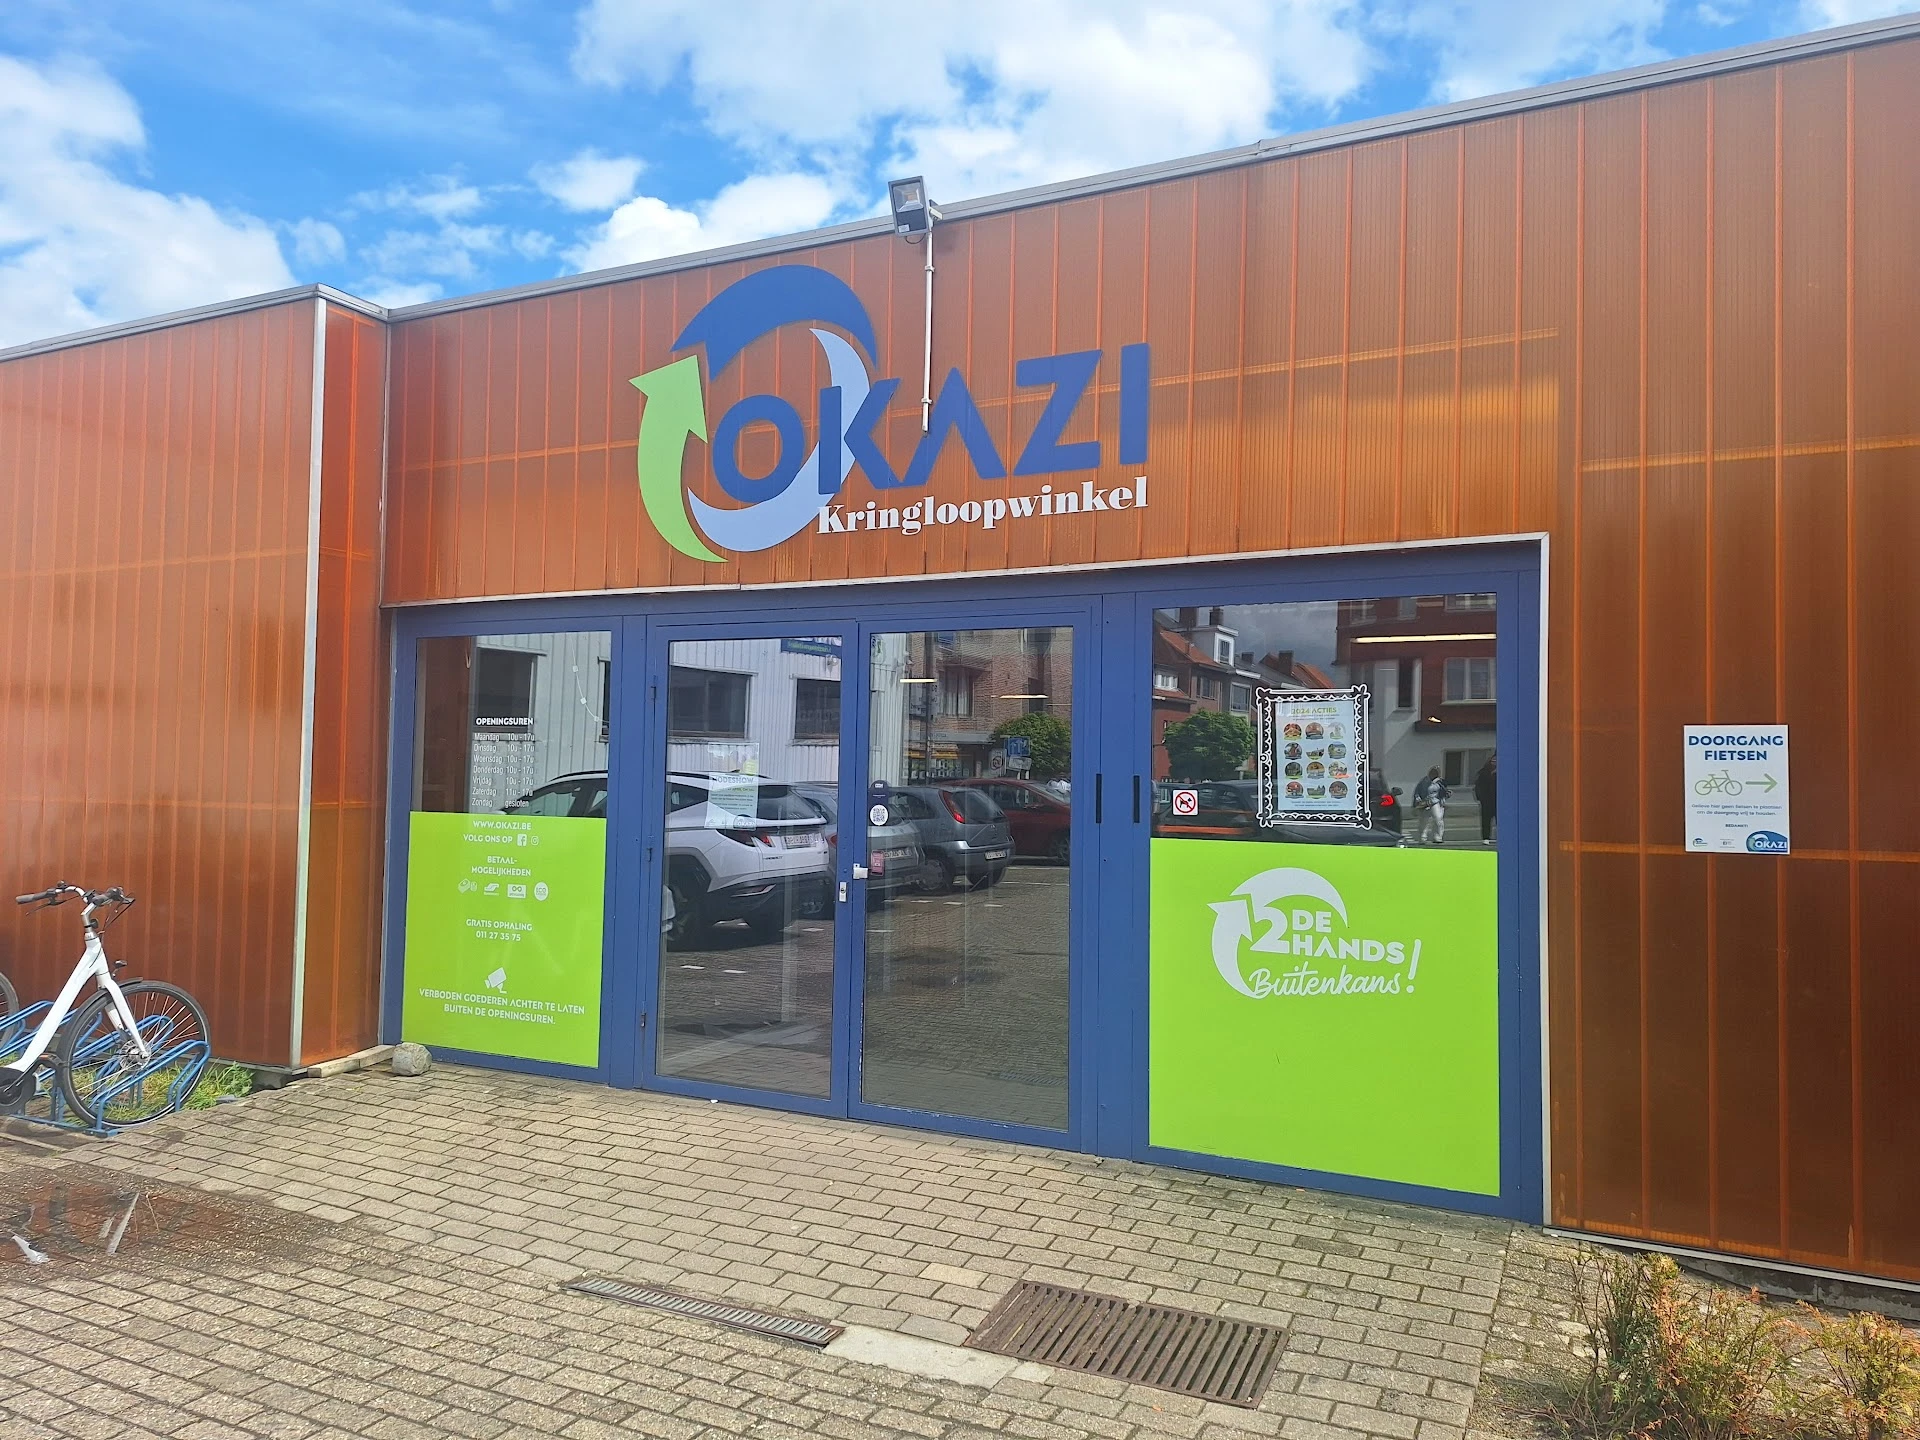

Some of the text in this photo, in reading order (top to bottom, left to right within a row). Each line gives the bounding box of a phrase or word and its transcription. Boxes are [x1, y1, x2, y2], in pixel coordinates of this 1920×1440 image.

[711, 342, 1150, 504] OKAZI
[816, 476, 1149, 536] Kringloopwinkel
[476, 717, 534, 726] OPENINGSUREN
[474, 733, 500, 742] Maandag
[508, 733, 518, 741] 10u
[524, 733, 535, 741] 17u
[1688, 735, 1784, 746] DOORGANG
[473, 744, 497, 753] Dinsdag
[507, 744, 517, 752] 10u
[524, 744, 535, 752] 17u
[473, 755, 503, 764] Woensdag
[507, 755, 517, 763] 10u
[523, 755, 534, 763] 17u
[1704, 750, 1768, 761] FIETSEN
[473, 766, 504, 775] Donderdag
[506, 766, 517, 774] 10u
[523, 766, 534, 774] 17u
[472, 777, 492, 786] Vrijdag
[506, 777, 517, 785] 10u
[523, 777, 534, 785] 17u
[472, 787, 497, 796] Zaterdag
[506, 788, 516, 796] 11u
[522, 788, 533, 796] 17u
[471, 798, 530, 808] Zondag gesloten
[473, 820, 532, 830] WWW.OKAZI.BE
[463, 833, 513, 844] VOLG ONS OP
[1755, 840, 1787, 849] OKAZI
[487, 855, 518, 865] BETAAL-
[471, 865, 531, 877] MOGELIJKHEDEN
[466, 918, 533, 931] GRATIS OPHALING
[1249, 905, 1332, 954] 2 DE
[475, 930, 521, 942] 011 27 35 75
[1292, 933, 1405, 965] HANDS
[419, 988, 585, 1015] VERBODEN GOEDEREN ACHTER TE LATEN
[444, 1003, 556, 1025] BUITEN DE OPENINGSUREN.
